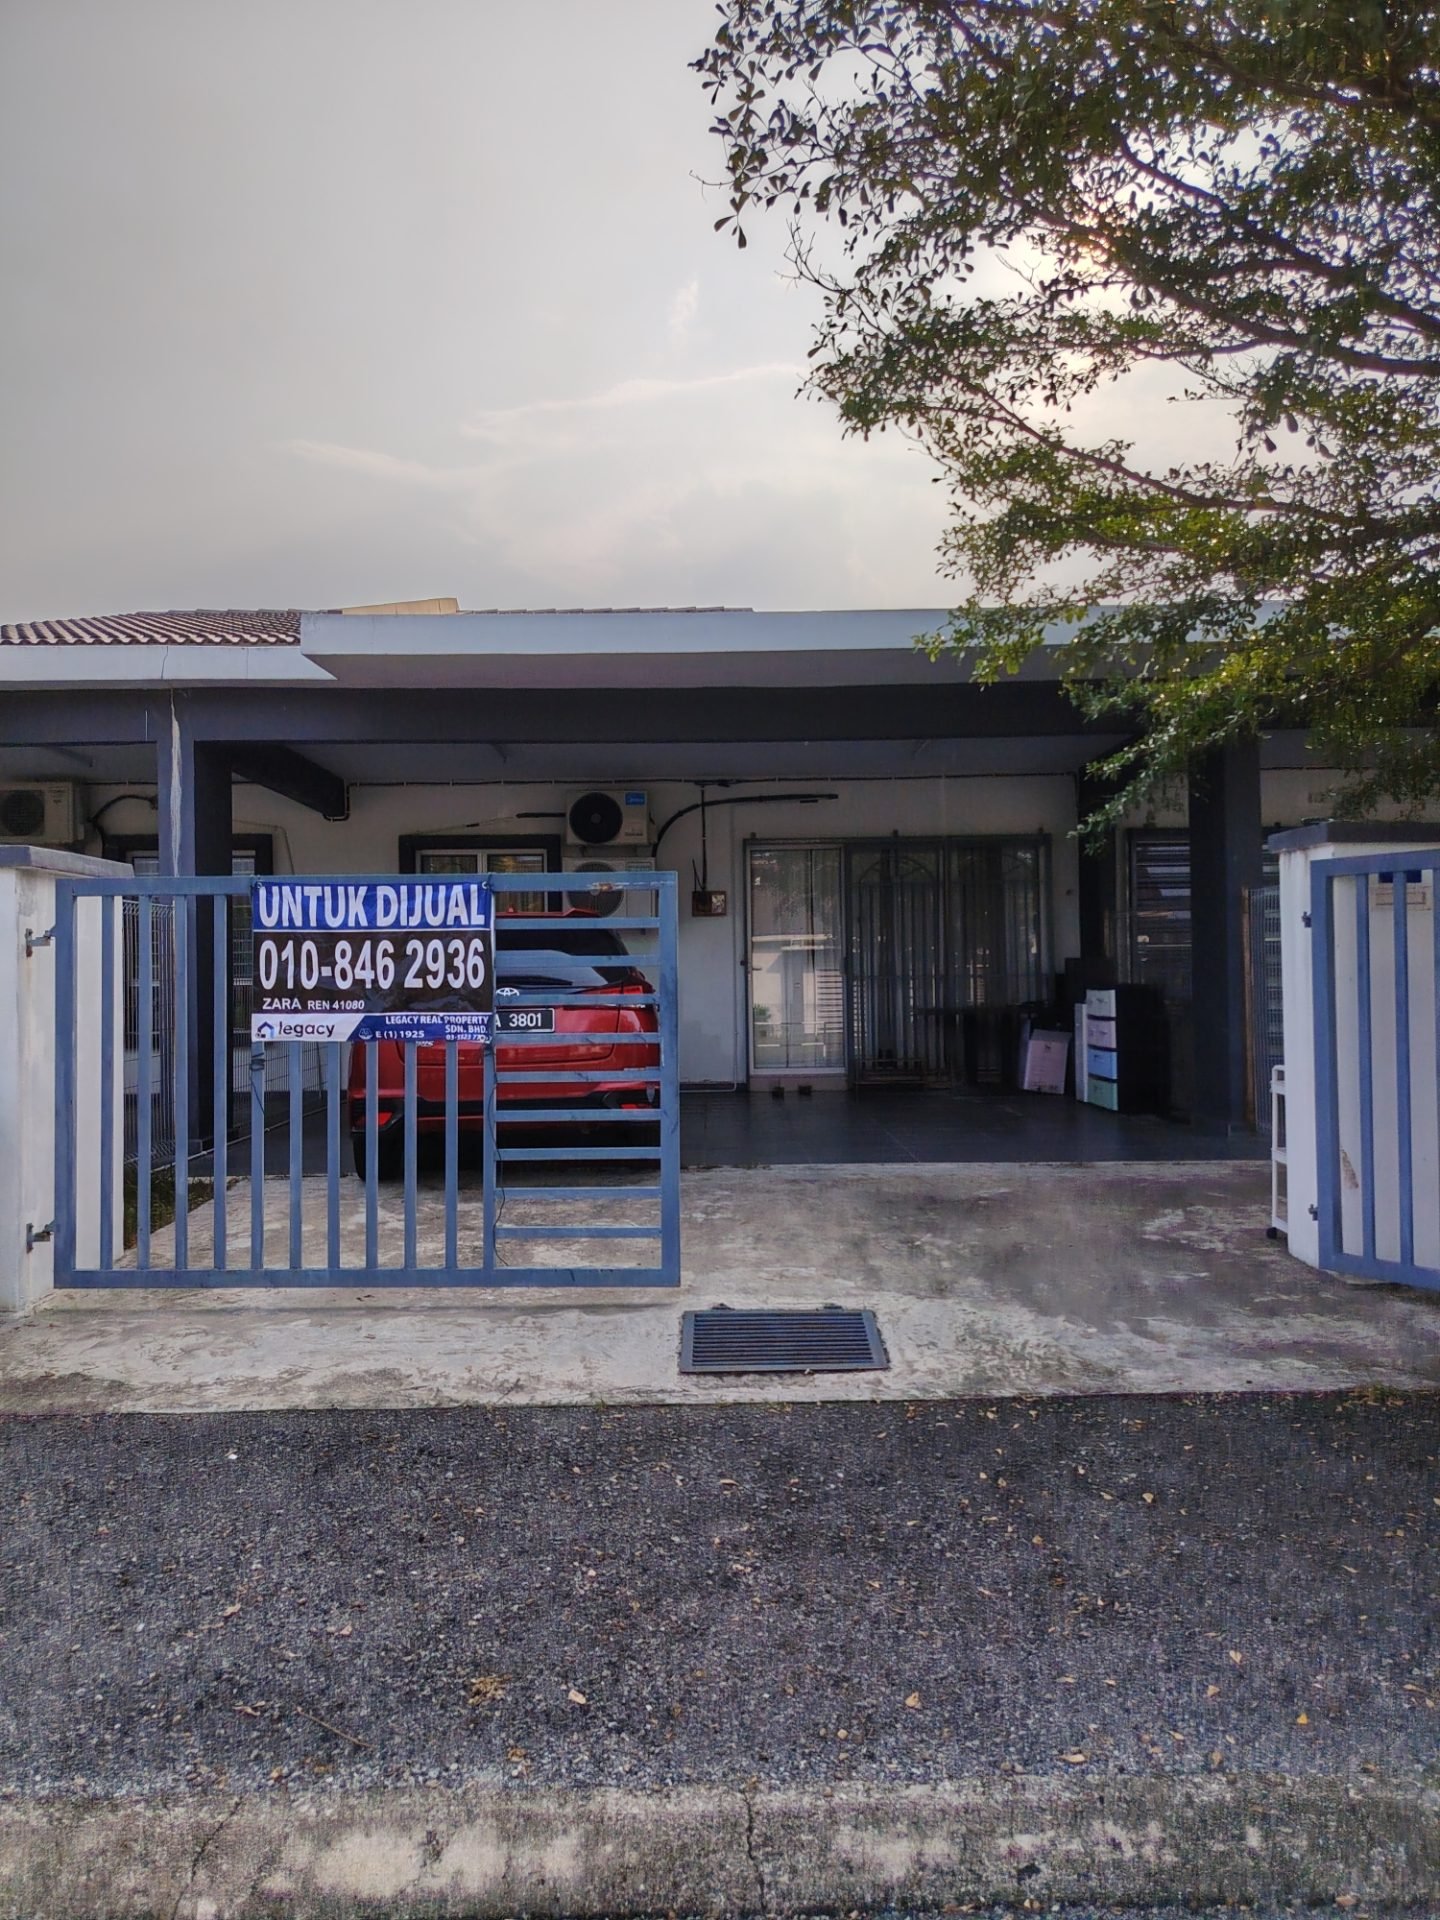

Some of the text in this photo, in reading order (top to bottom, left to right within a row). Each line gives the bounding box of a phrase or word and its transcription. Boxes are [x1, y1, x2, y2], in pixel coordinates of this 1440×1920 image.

[258, 883, 486, 928] UNTUK DIJUAL
[258, 938, 486, 990] 010-846 2936
[262, 997, 365, 1010] ZARA REN 41080
[385, 1015, 489, 1025] LEGACY REAL PROPERTY
[508, 1012, 542, 1028] 3801
[278, 1021, 335, 1038] legacy
[375, 1030, 425, 1039] E (1) 1925
[445, 1025, 488, 1034] SDN. BHD.
